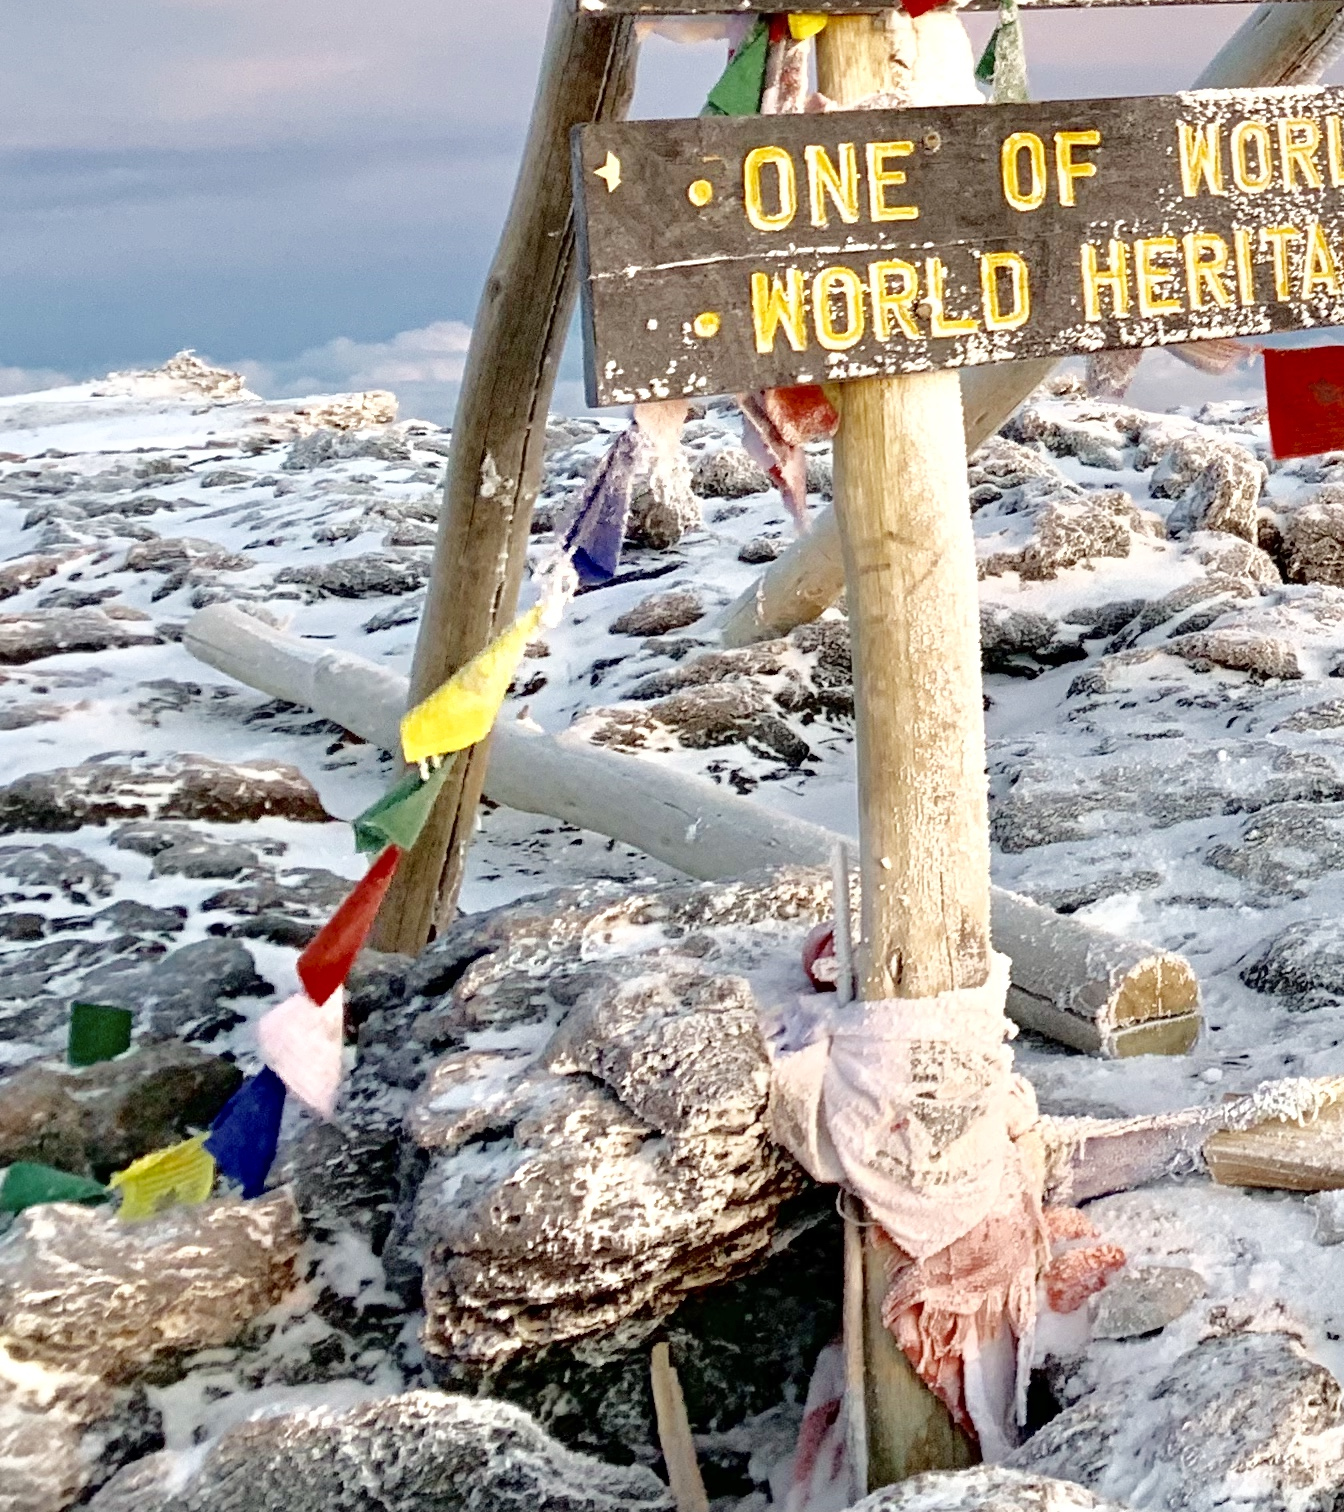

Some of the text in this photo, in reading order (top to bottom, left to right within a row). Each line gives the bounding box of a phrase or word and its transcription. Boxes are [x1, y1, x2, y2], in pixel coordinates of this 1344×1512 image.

[743, 139, 920, 232] ONE
[1001, 129, 1101, 212] OF
[750, 251, 1031, 355] WORLD
